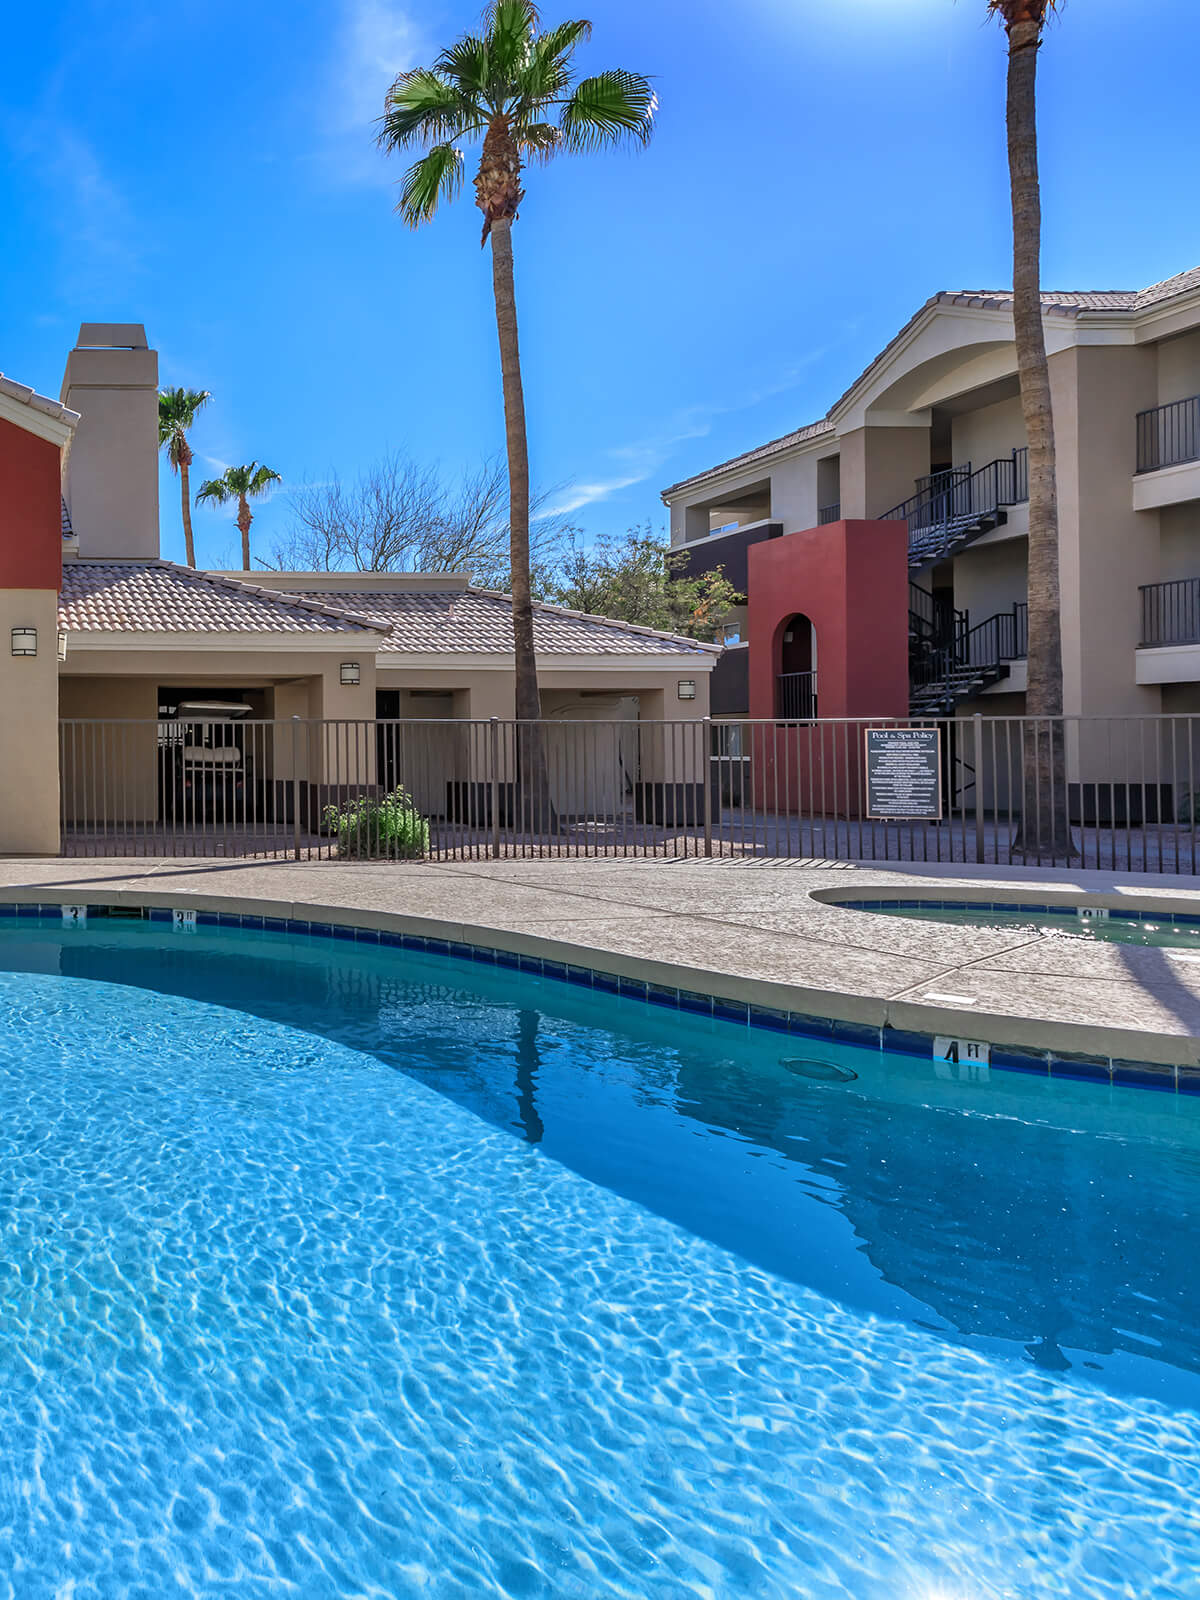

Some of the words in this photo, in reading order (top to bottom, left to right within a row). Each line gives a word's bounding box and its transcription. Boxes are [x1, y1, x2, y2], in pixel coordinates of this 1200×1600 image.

[872, 731, 889, 739] Pool
[897, 731, 911, 740] Spa
[912, 731, 934, 740] Policy
[944, 1041, 959, 1063] 4
[968, 1043, 980, 1058] FT
